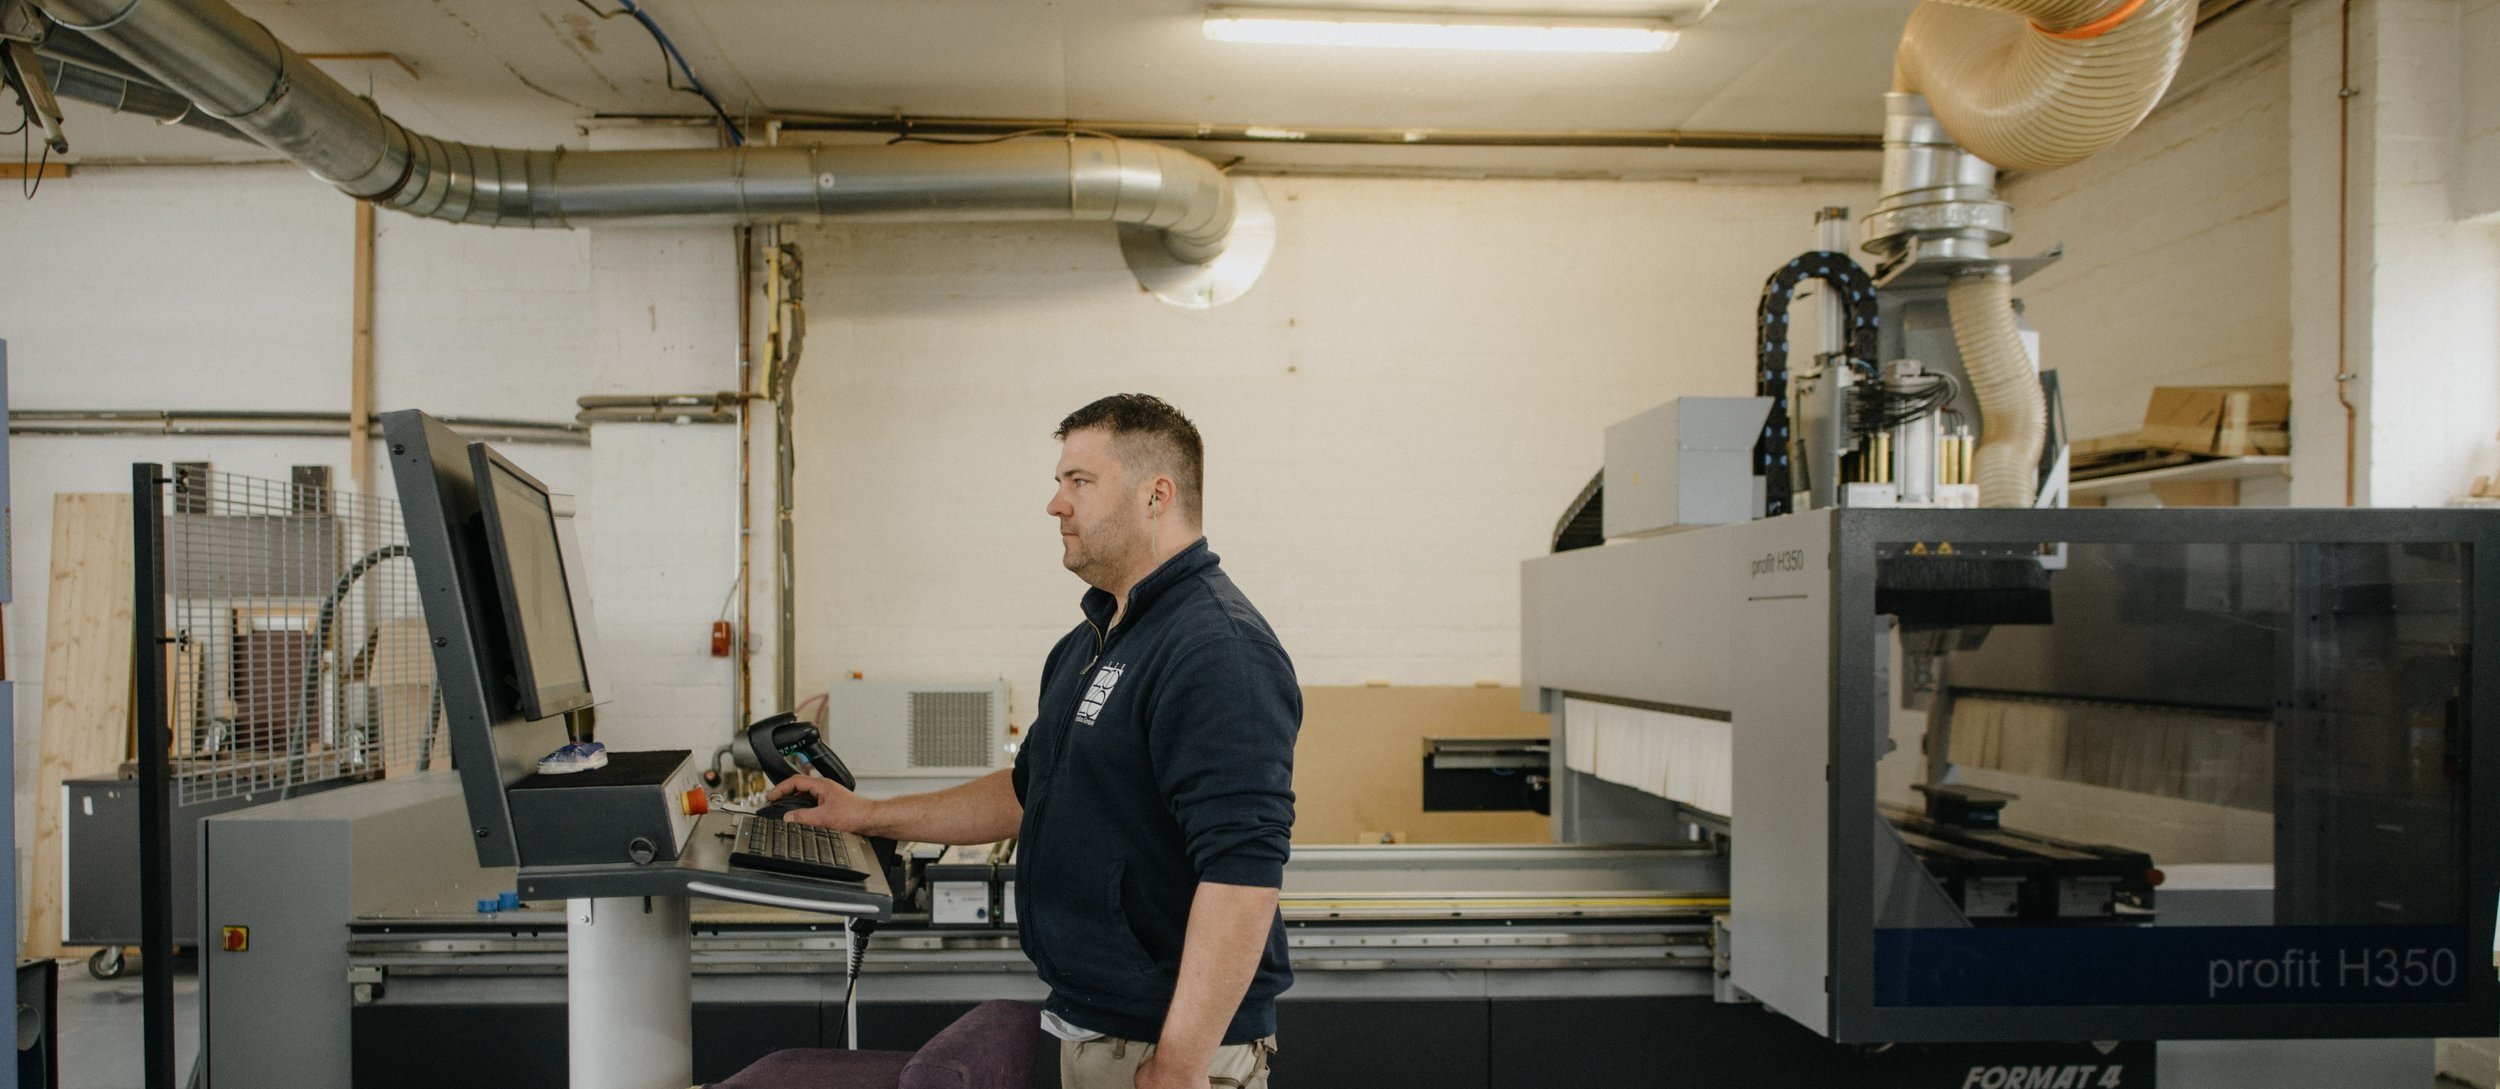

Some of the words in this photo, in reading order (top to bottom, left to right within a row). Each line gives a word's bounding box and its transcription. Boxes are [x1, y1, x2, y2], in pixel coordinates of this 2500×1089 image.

[1752, 553, 1774, 578] profit
[1777, 549, 1804, 571] H350
[2209, 949, 2321, 998] profit
[2339, 948, 2457, 987] H350
[1962, 1065, 2098, 1089] FORMAT
[2098, 1065, 2124, 1089] 4
